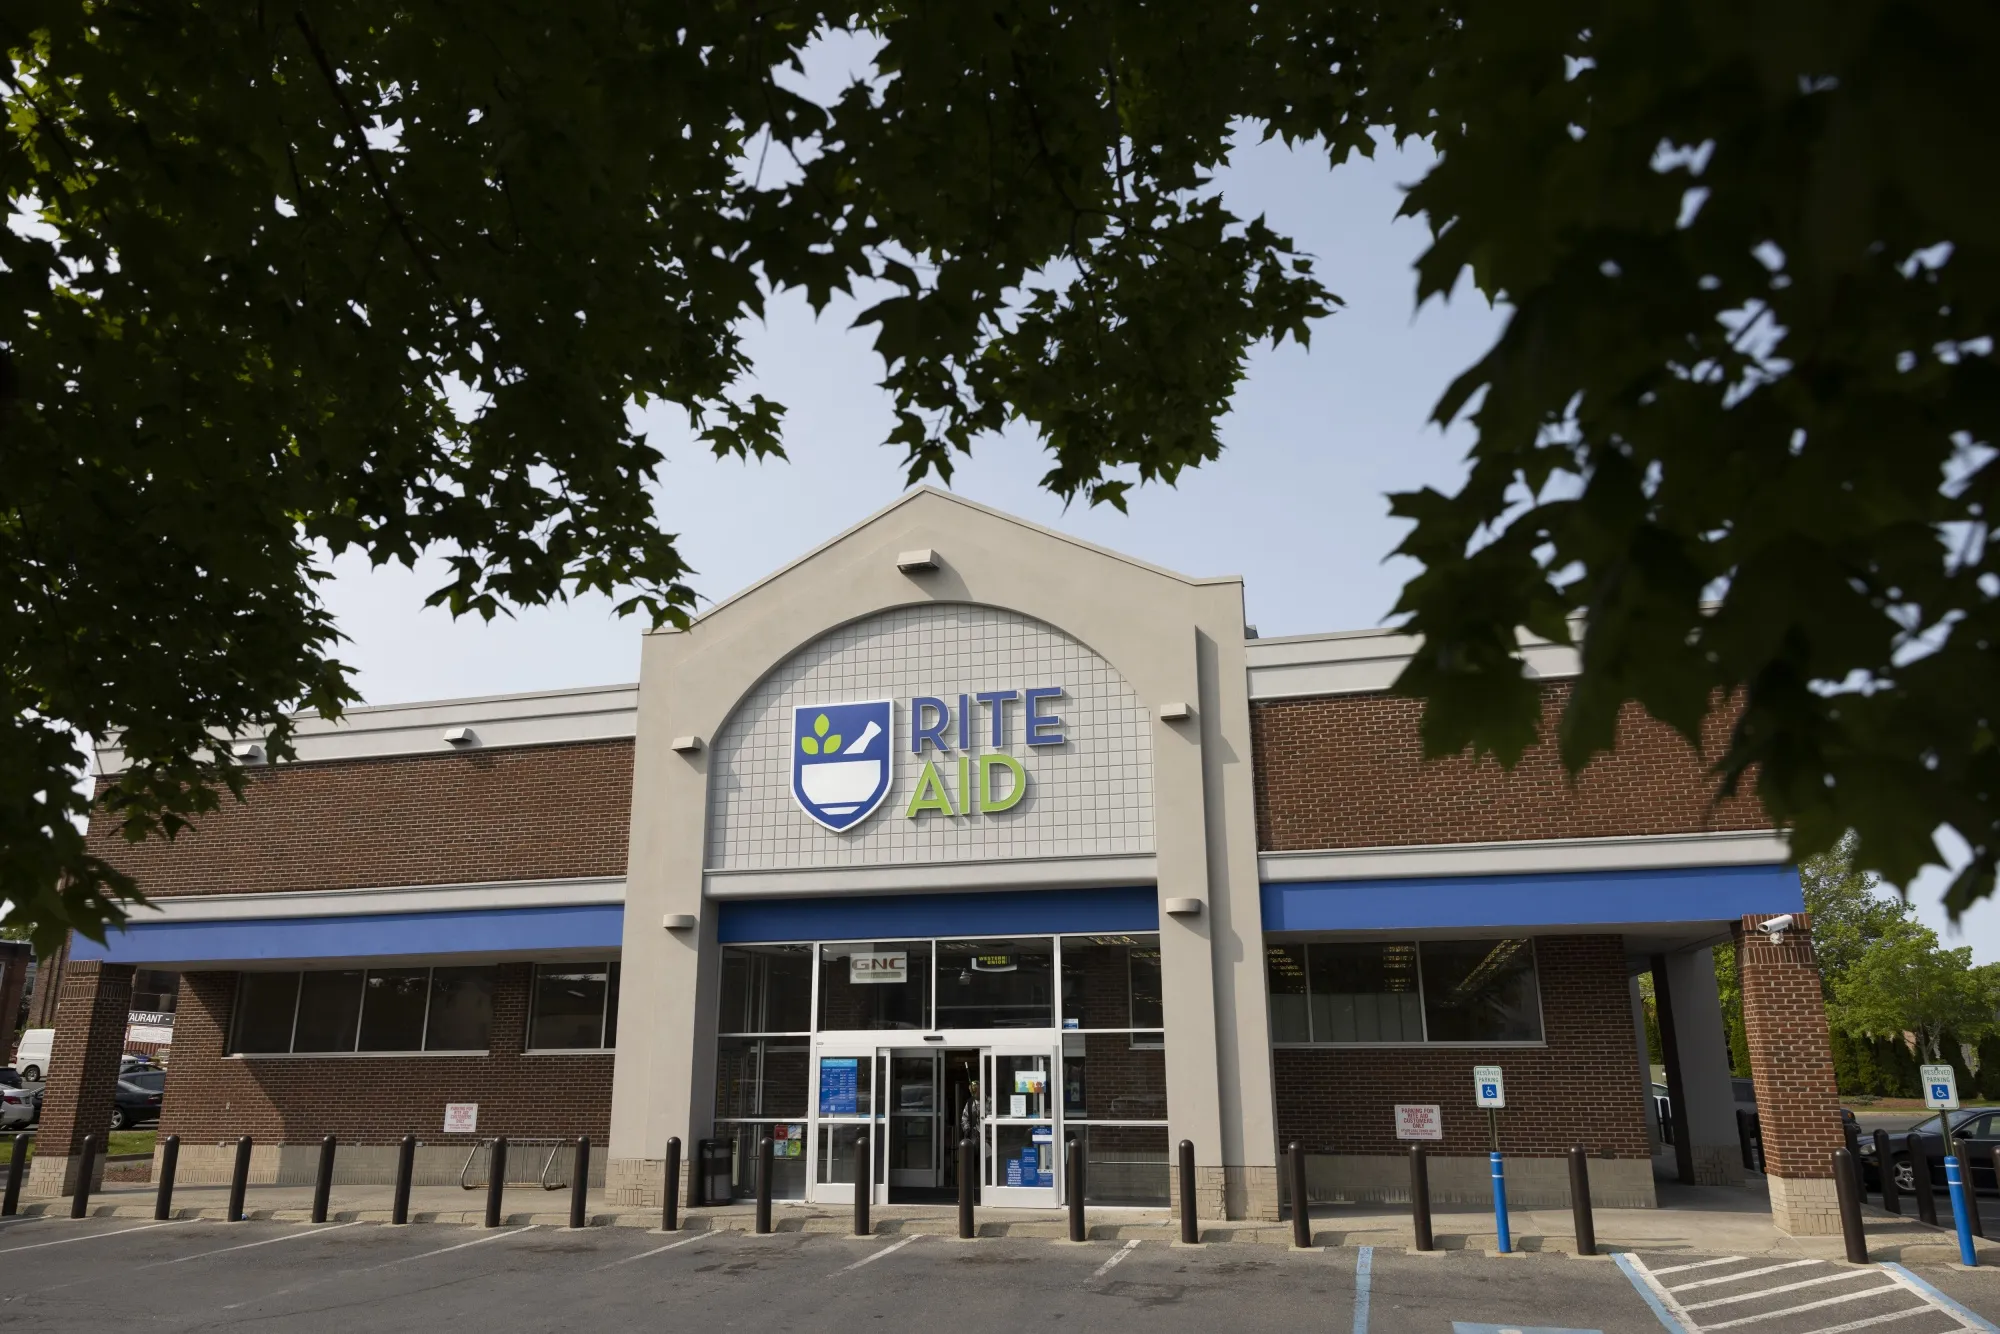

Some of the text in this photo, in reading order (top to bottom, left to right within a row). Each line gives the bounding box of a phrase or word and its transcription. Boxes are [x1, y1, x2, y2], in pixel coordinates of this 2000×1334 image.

[911, 686, 1065, 754] RITE
[905, 753, 1027, 818] AID
[852, 957, 905, 970] GNC
